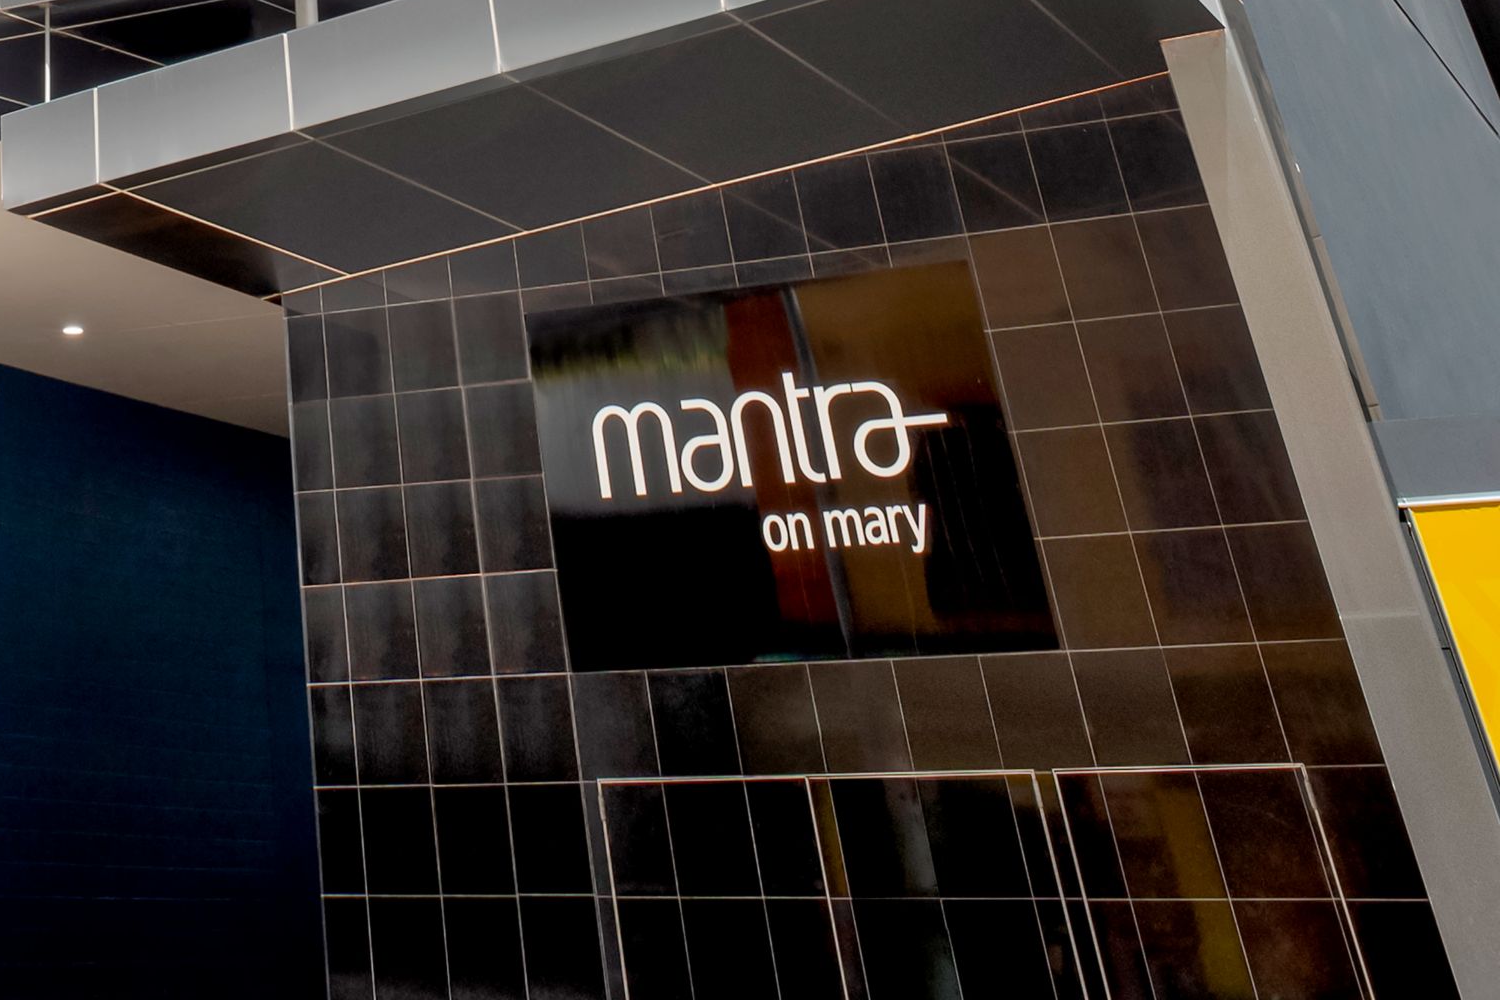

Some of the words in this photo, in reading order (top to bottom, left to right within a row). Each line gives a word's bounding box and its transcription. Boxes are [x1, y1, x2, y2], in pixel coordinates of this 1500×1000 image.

[592, 371, 948, 499] mantra
[762, 511, 815, 552] on
[822, 503, 927, 554] mary
